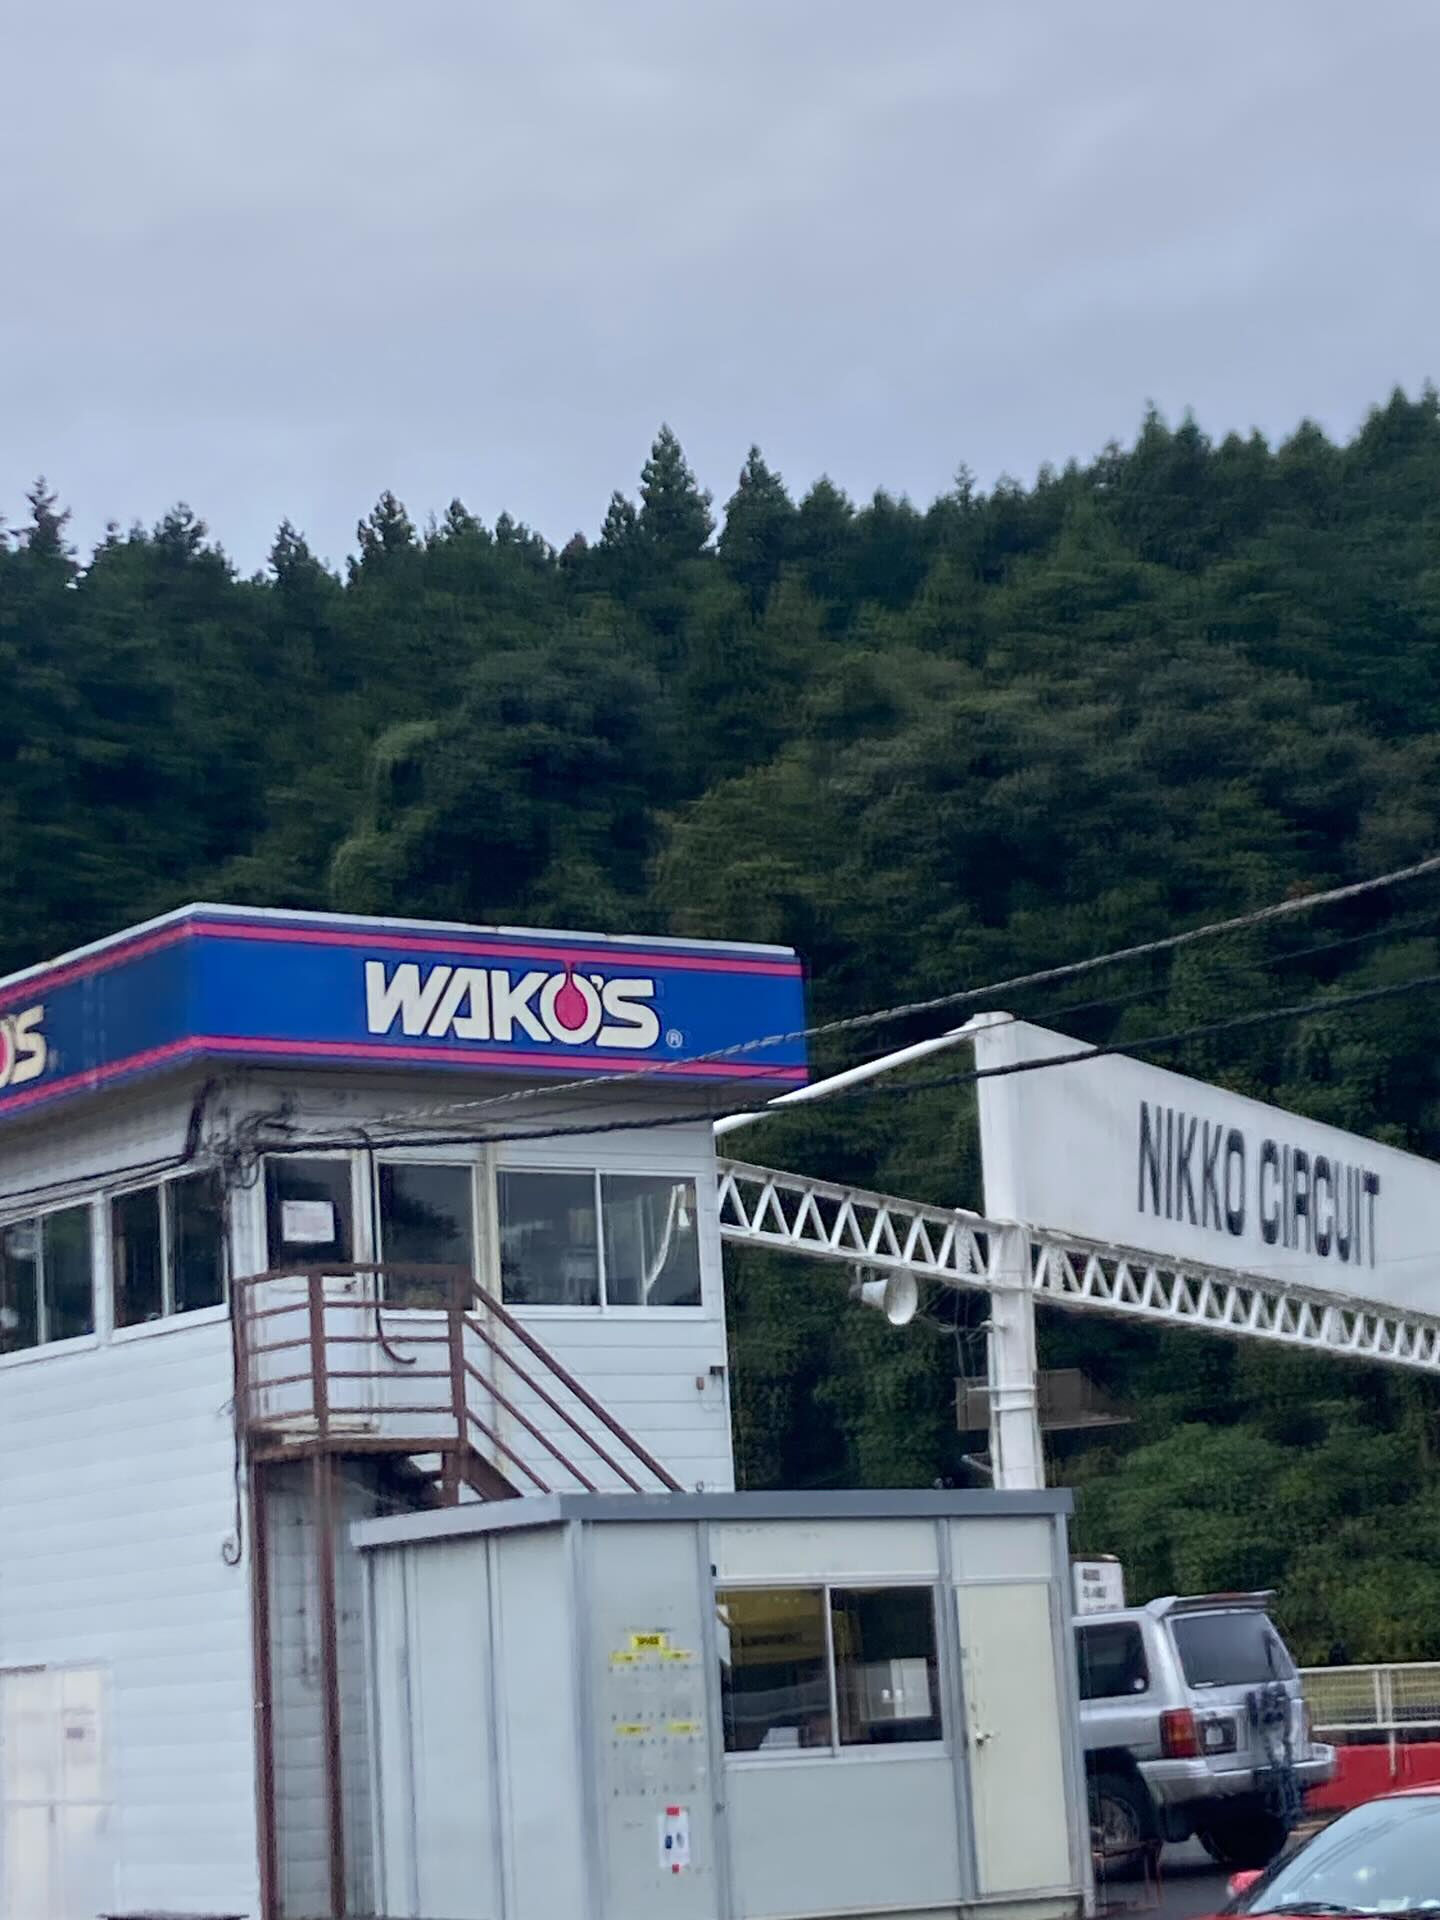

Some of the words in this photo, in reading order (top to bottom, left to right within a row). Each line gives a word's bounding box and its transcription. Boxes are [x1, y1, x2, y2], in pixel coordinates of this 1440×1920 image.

[365, 961, 660, 1049] WAKO'S
[1138, 1100, 1246, 1236] NIKKO
[1260, 1139, 1380, 1269] CIRCUIT
